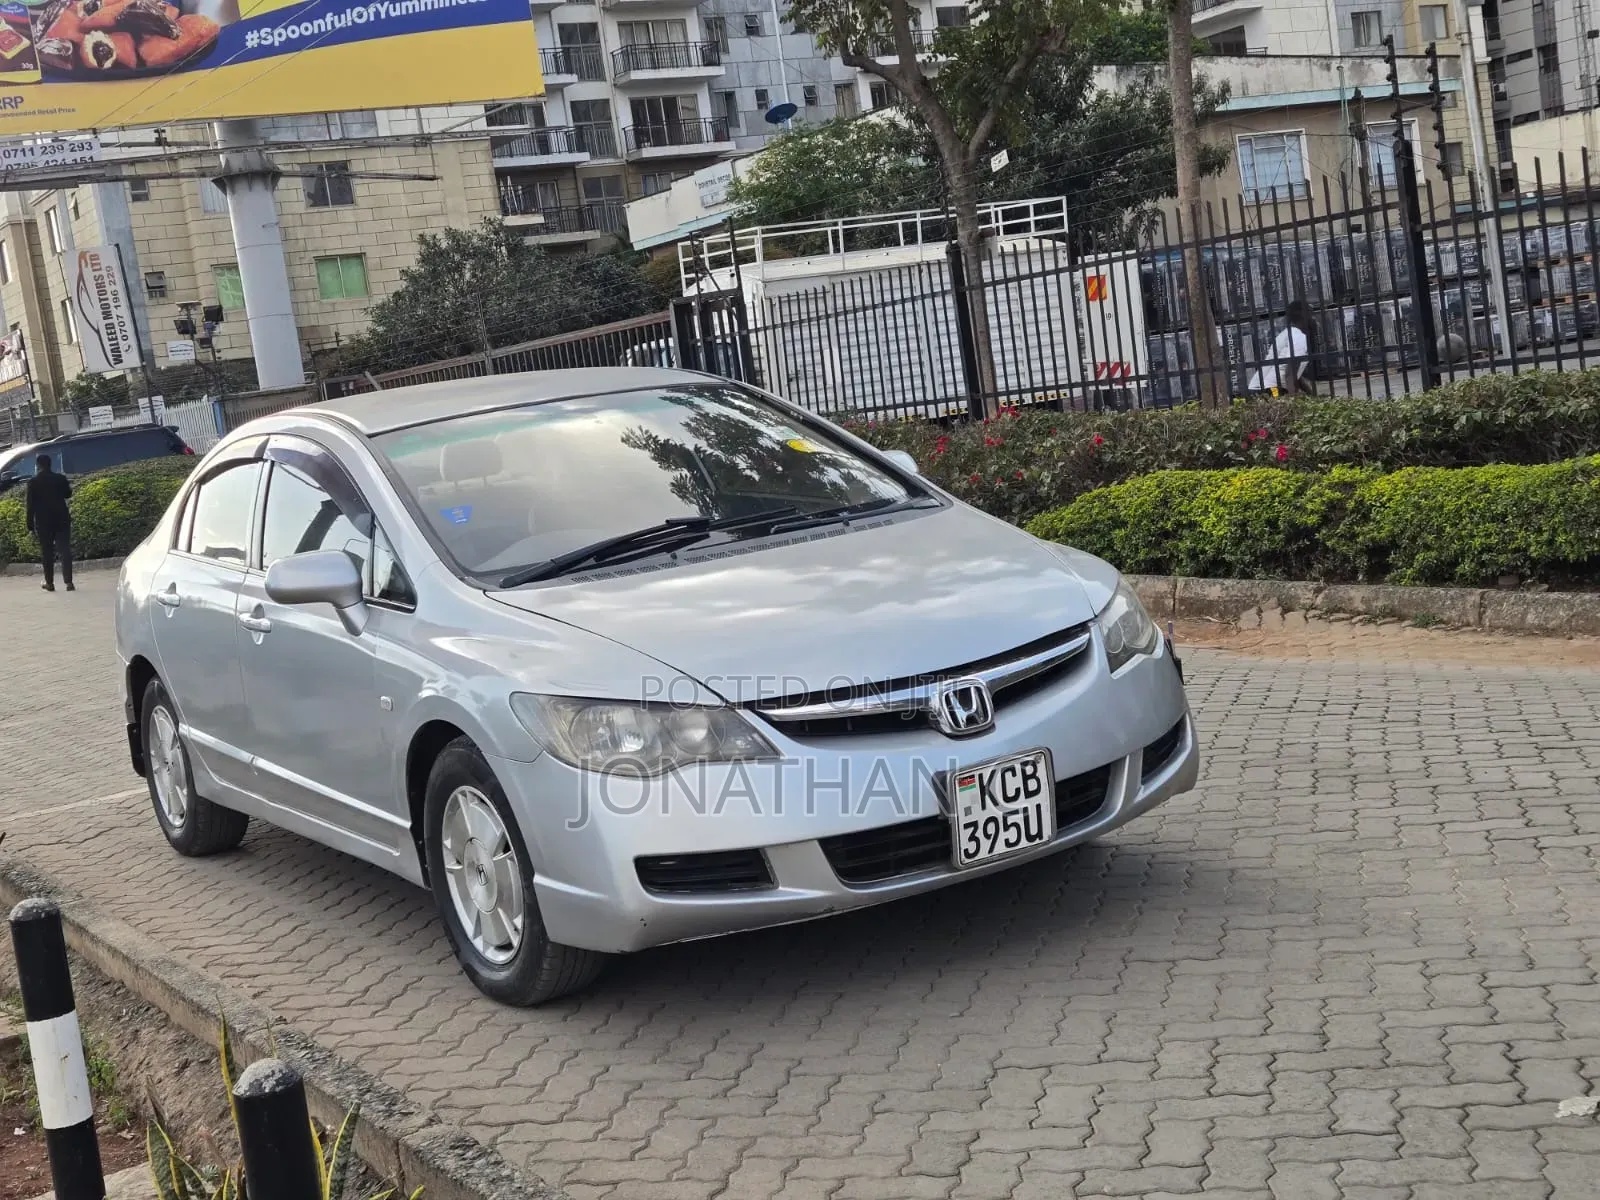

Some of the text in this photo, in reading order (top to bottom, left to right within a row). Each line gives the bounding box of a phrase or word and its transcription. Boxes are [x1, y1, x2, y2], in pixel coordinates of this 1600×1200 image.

[246, 0, 487, 48] #SpoonfulOfYummin
[0, 95, 24, 110] RP
[3, 141, 93, 158] 0711 239 293
[89, 253, 124, 366] WALEED MOTORS LTD
[105, 265, 129, 342] 0707 196 229
[978, 760, 1042, 811] KCB
[963, 803, 1044, 859] 395U
